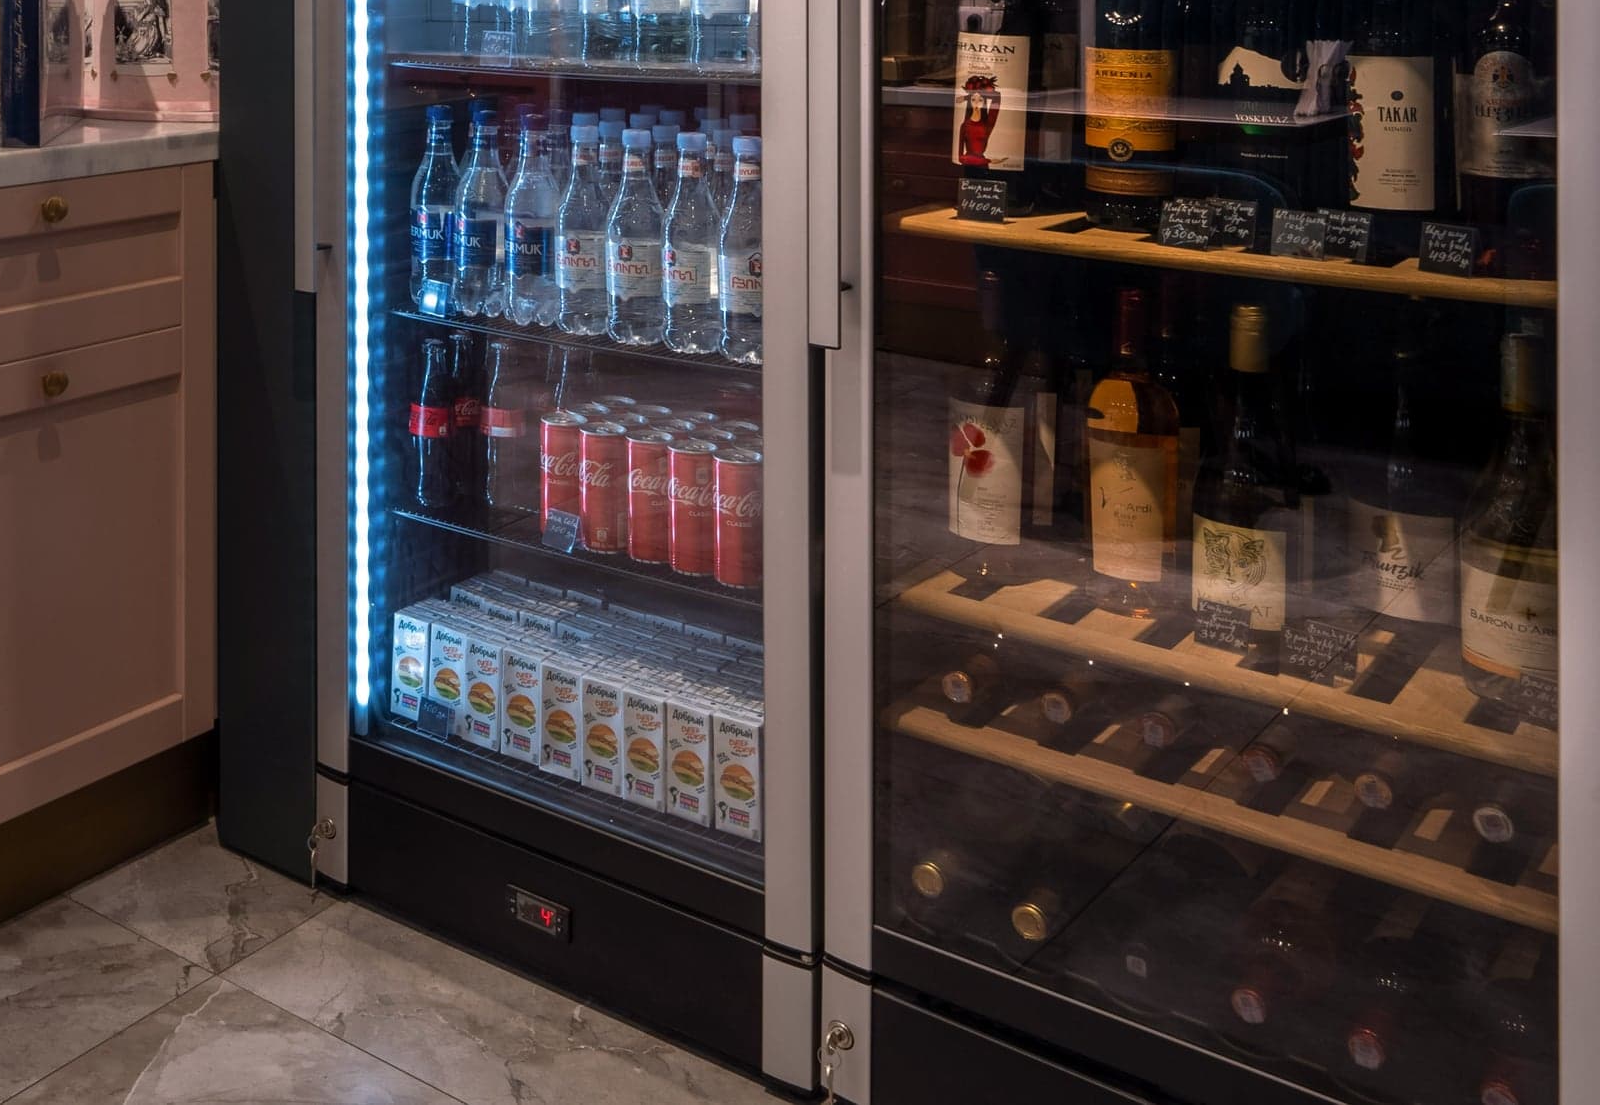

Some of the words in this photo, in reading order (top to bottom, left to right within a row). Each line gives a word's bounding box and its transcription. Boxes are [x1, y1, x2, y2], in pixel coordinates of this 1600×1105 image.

[1095, 70, 1153, 79] ARMENIA
[1234, 113, 1289, 125] VOSKEVAZ
[1377, 106, 1418, 124] TAKAR
[410, 225, 445, 241] ERMUK
[505, 240, 543, 256] ERMUK
[731, 276, 762, 290] ԲՅՈՒ
[1470, 607, 1513, 630] BARON
[436, 631, 462, 646] Добрый
[470, 643, 497, 659] Добрый
[507, 655, 537, 672] Добрый
[546, 670, 577, 687] Добрый
[586, 684, 617, 701] Добрый
[627, 697, 658, 714] Добрый
[672, 708, 704, 727] Добрый
[719, 722, 752, 739] Добрый
